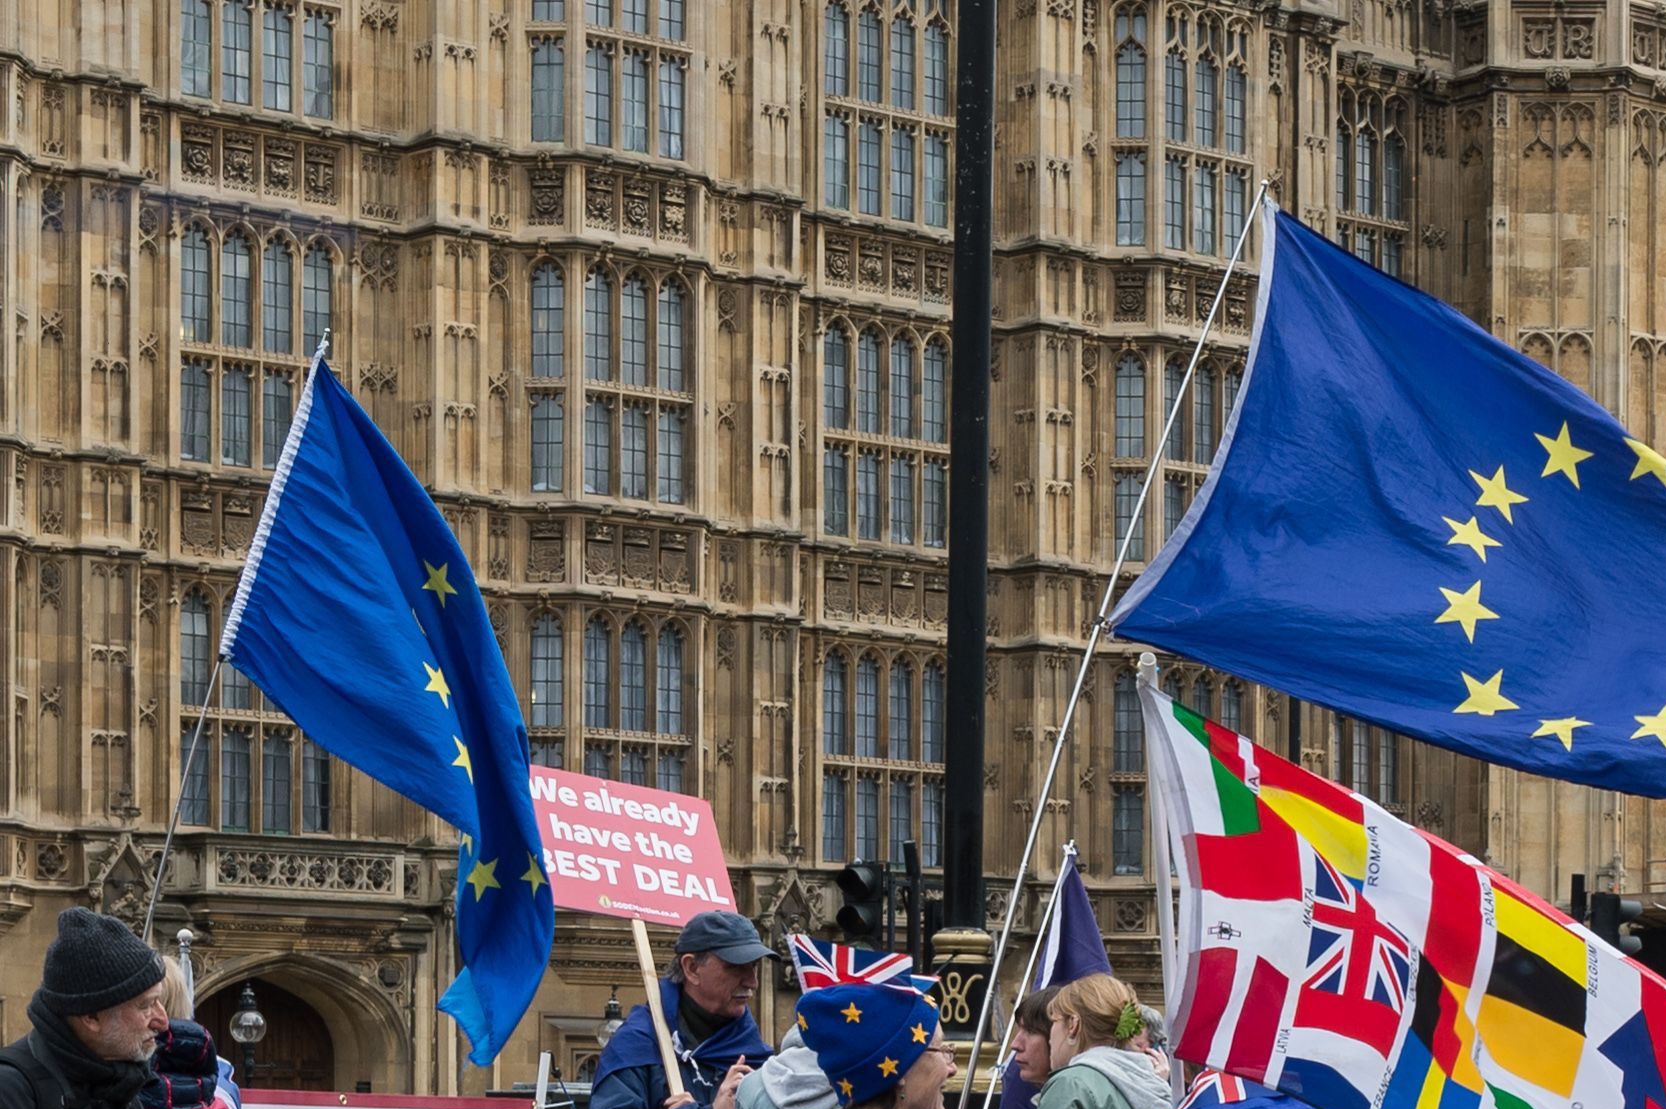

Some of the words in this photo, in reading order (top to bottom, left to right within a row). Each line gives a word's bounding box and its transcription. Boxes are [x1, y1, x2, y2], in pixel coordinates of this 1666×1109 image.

[528, 775, 578, 807] We
[583, 787, 699, 836] already
[549, 812, 632, 852] have
[634, 831, 693, 864] the
[542, 847, 621, 885] BEST
[633, 863, 730, 906] DEAL
[1302, 887, 1315, 929] MALTA
